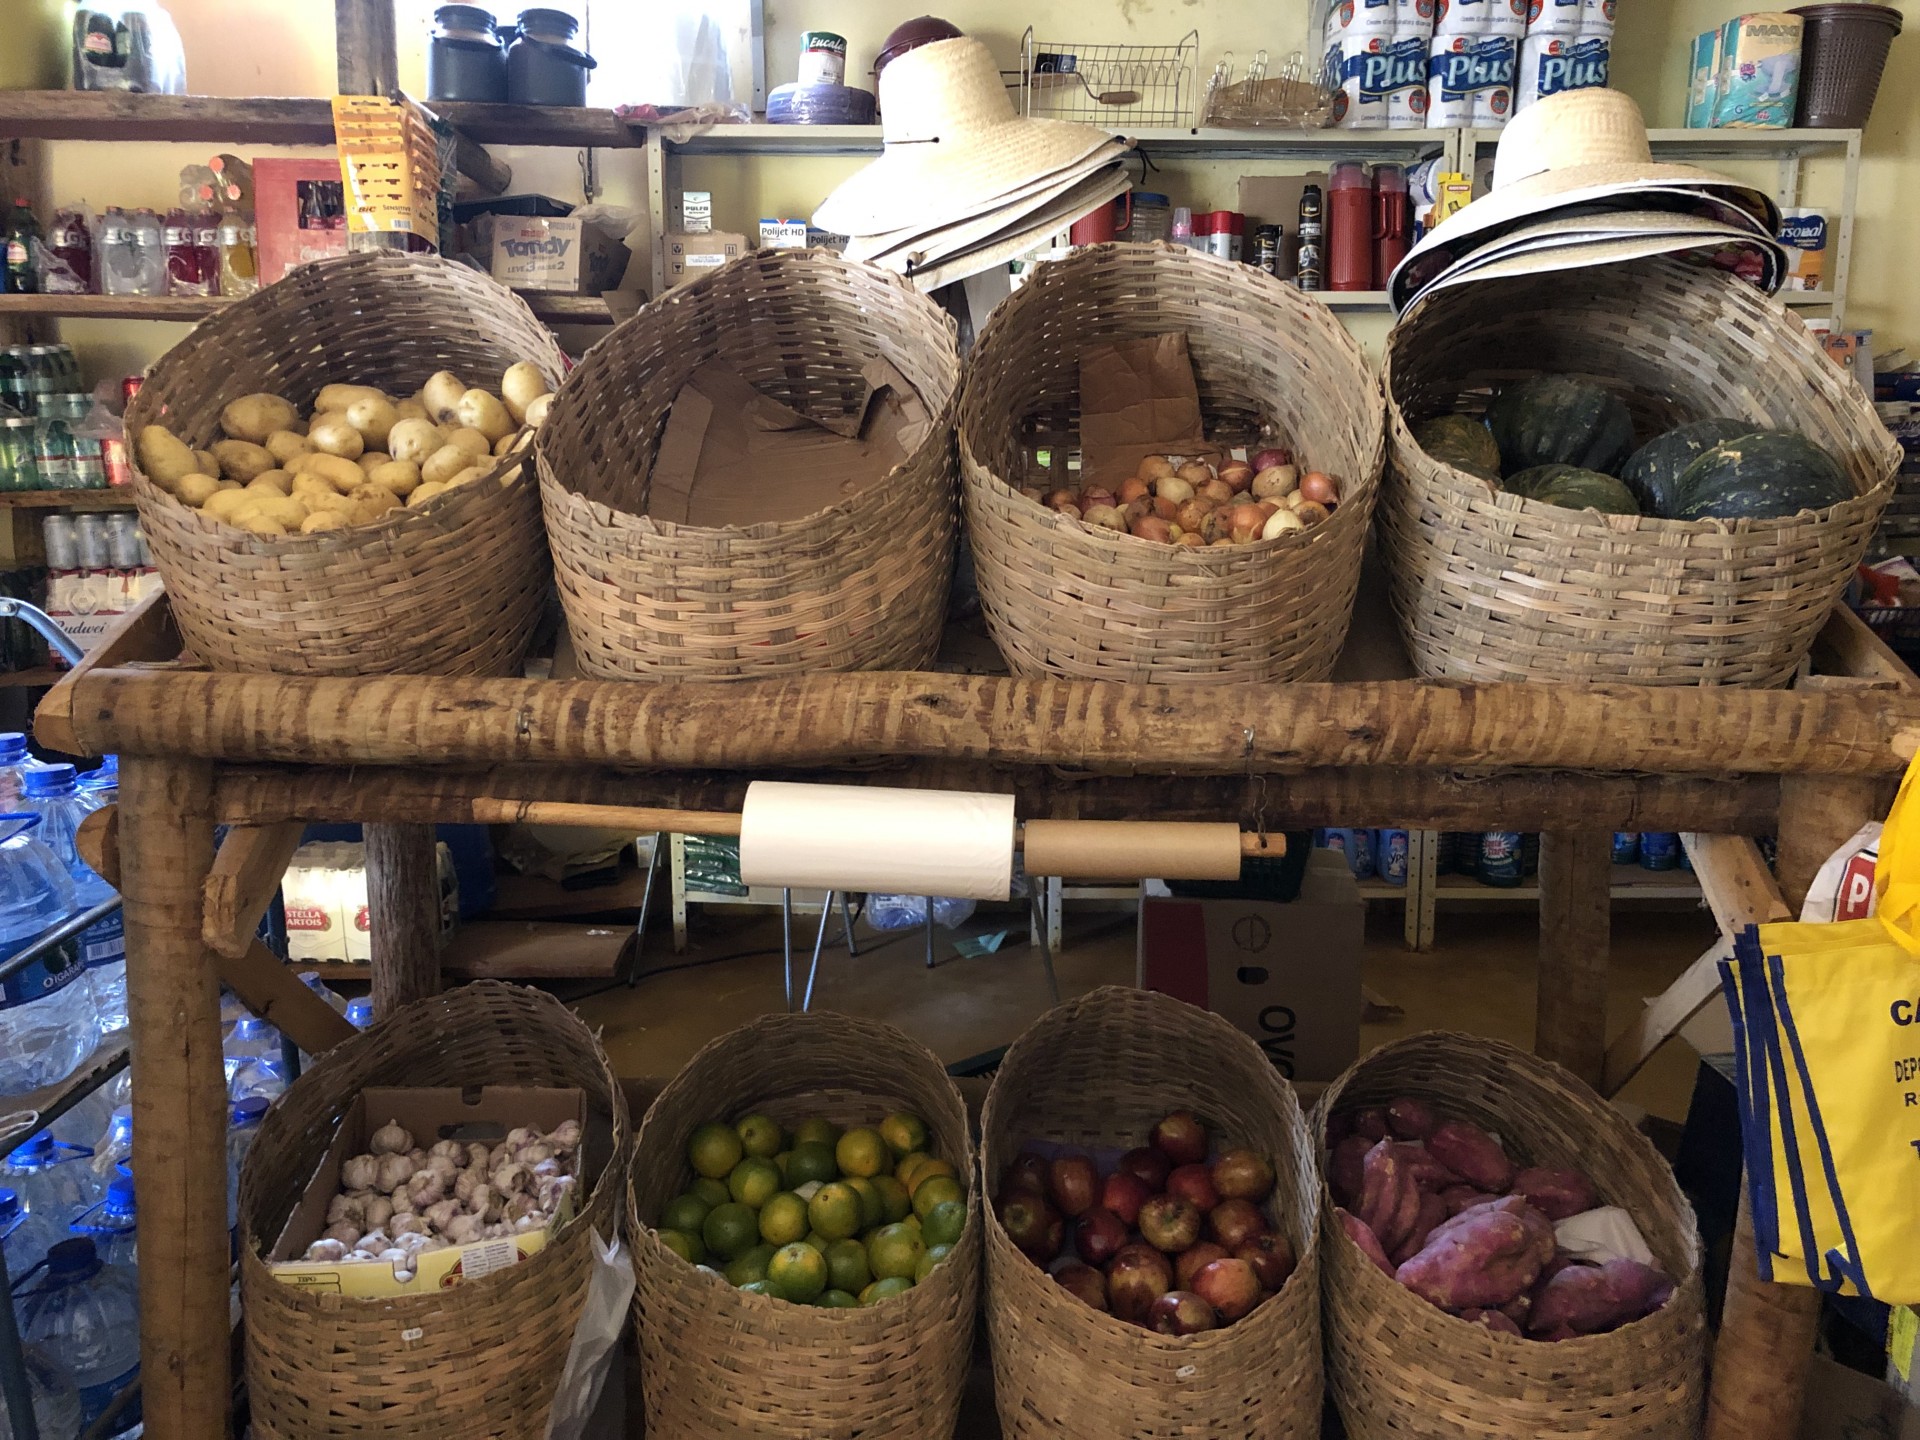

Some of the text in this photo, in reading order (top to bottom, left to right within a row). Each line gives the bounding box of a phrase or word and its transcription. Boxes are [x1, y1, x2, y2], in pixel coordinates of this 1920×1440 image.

[1746, 25, 1800, 37] MAXI
[1365, 56, 1427, 88] Plus
[1447, 55, 1513, 87] Plus
[1543, 57, 1607, 91] Plus
[761, 227, 789, 238] Polijet
[500, 236, 571, 258] Tandy
[811, 236, 837, 246] Polijet
[557, 261, 565, 271] 2
[287, 910, 321, 919] STELLA
